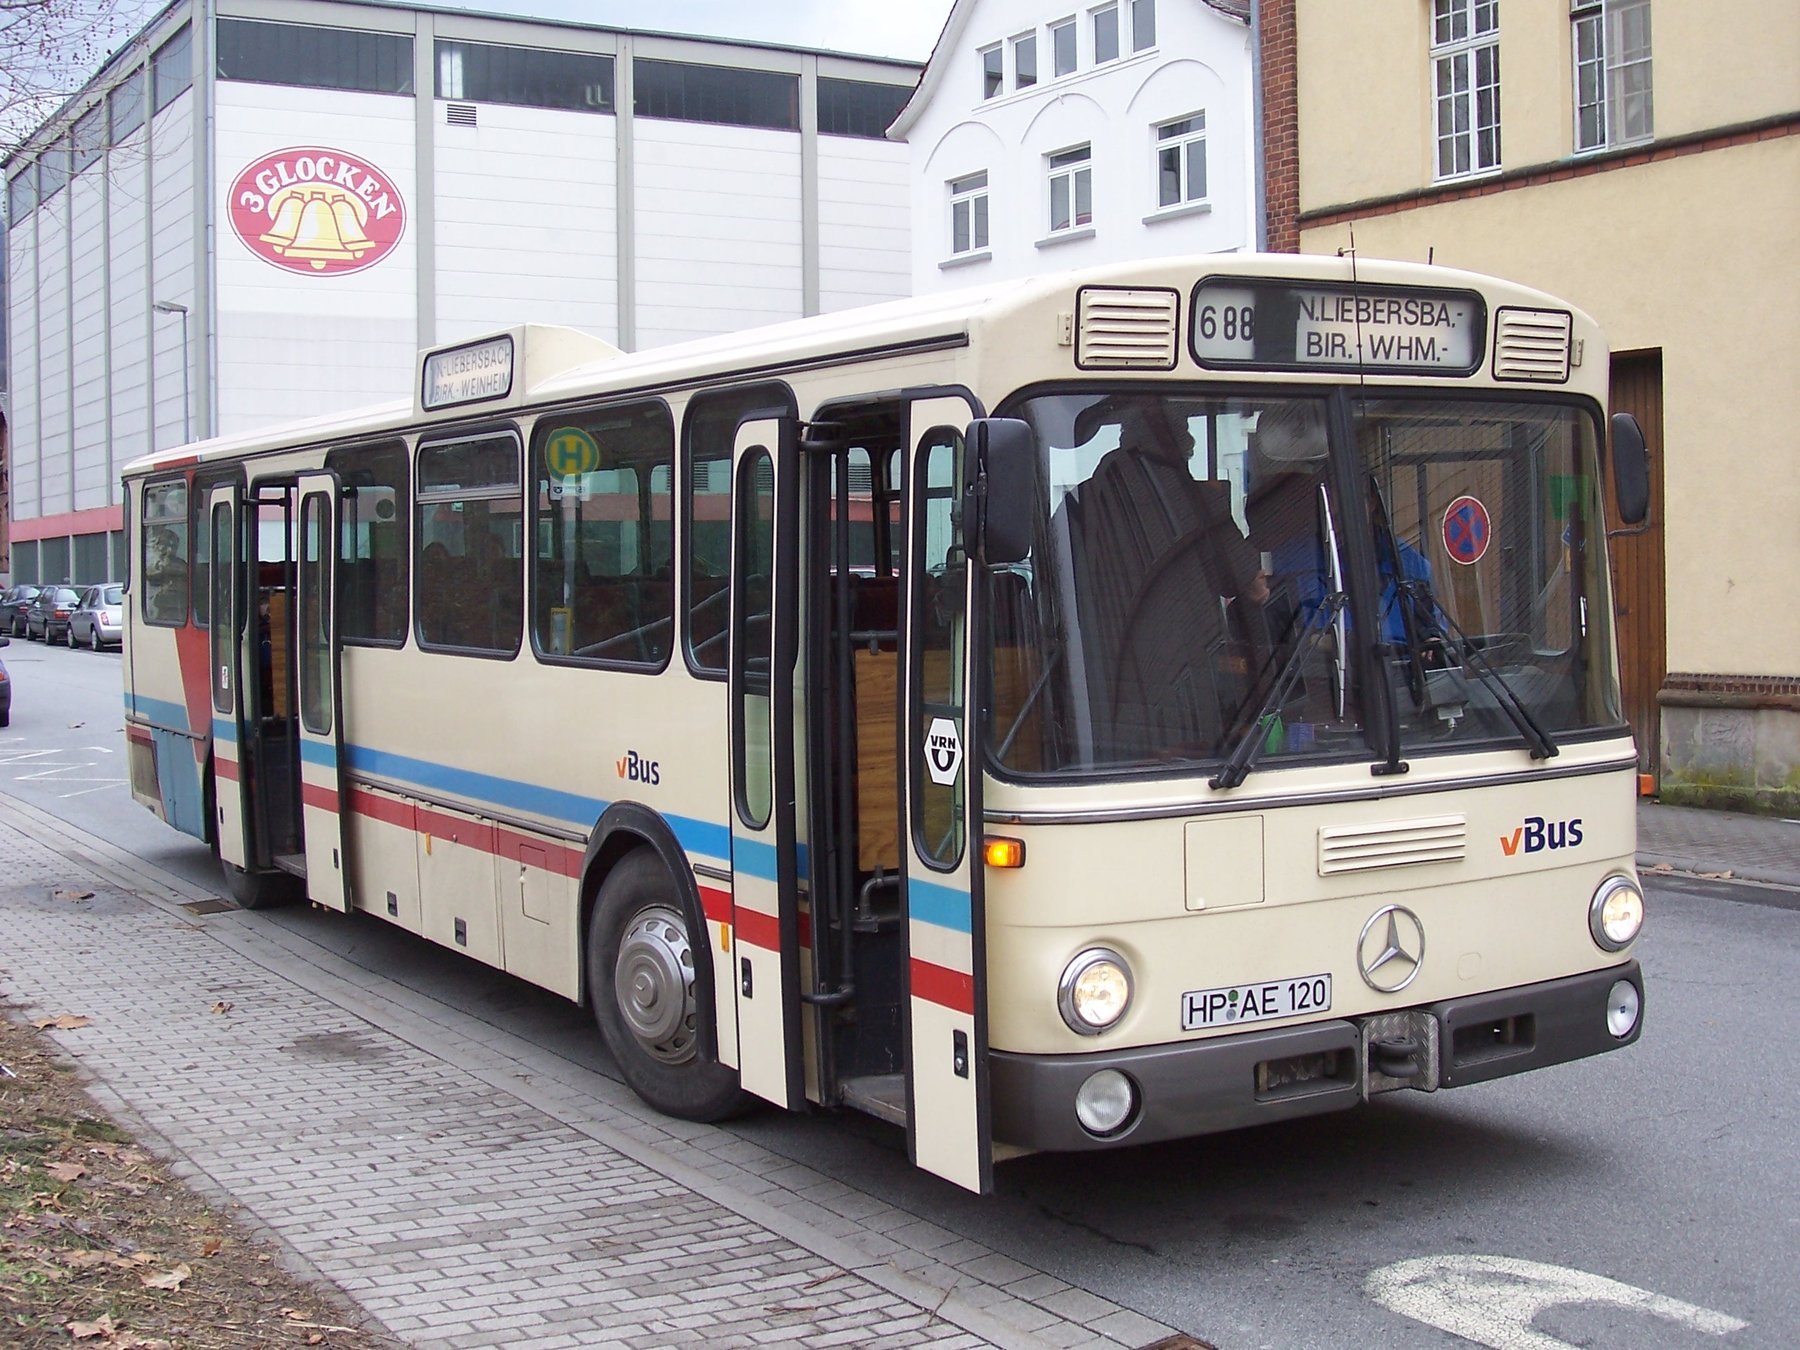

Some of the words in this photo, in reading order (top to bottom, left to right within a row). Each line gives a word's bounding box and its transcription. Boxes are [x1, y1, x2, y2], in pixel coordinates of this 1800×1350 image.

[241, 191, 264, 213] 3
[255, 157, 397, 220] GLOCKEN
[1199, 305, 1255, 341] 688
[558, 440, 583, 470] H
[930, 734, 956, 750] VRN
[1288, 979, 1326, 1011] 120
